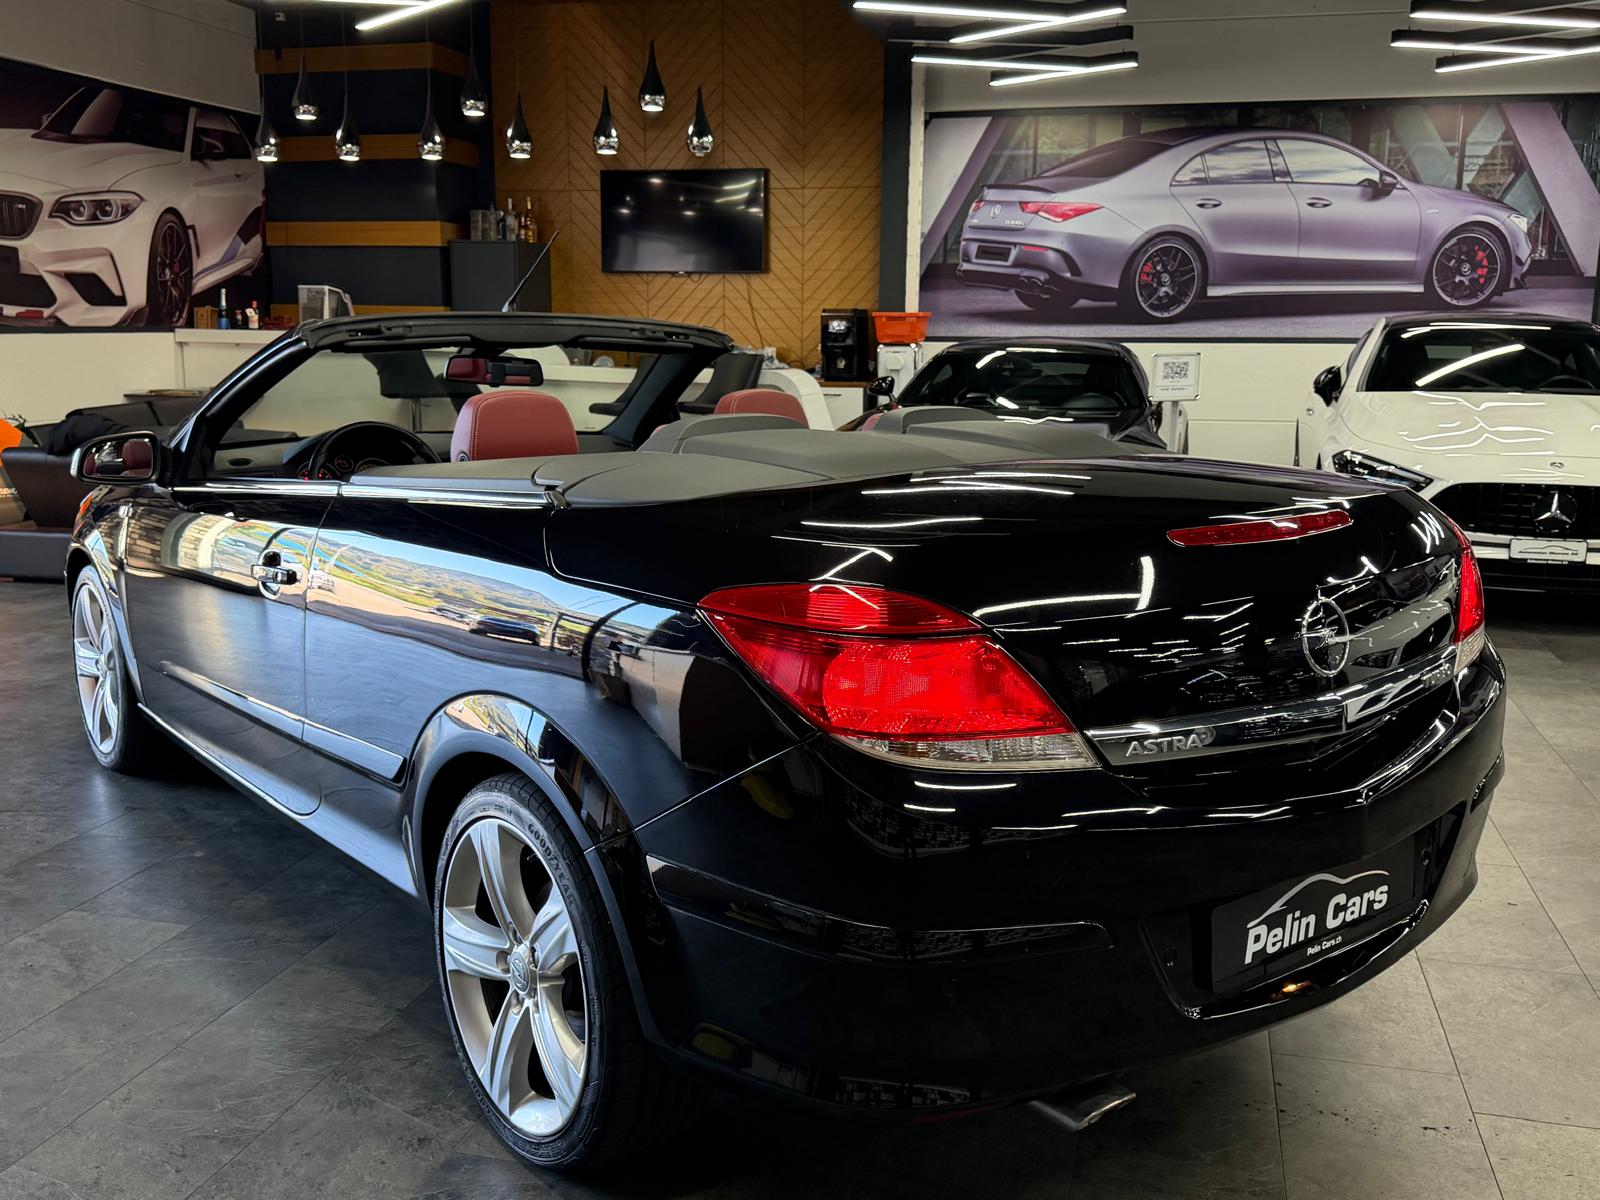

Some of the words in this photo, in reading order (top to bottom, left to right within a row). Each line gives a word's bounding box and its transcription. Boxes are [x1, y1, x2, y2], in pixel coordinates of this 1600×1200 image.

[1125, 734, 1203, 757] ASTRA
[527, 822, 576, 906] GOODYEAR
[1244, 910, 1316, 965] Pelin
[1326, 885, 1389, 929] Cars
[1307, 944, 1322, 957] Pelin
[1321, 935, 1343, 950] Cars.ch
